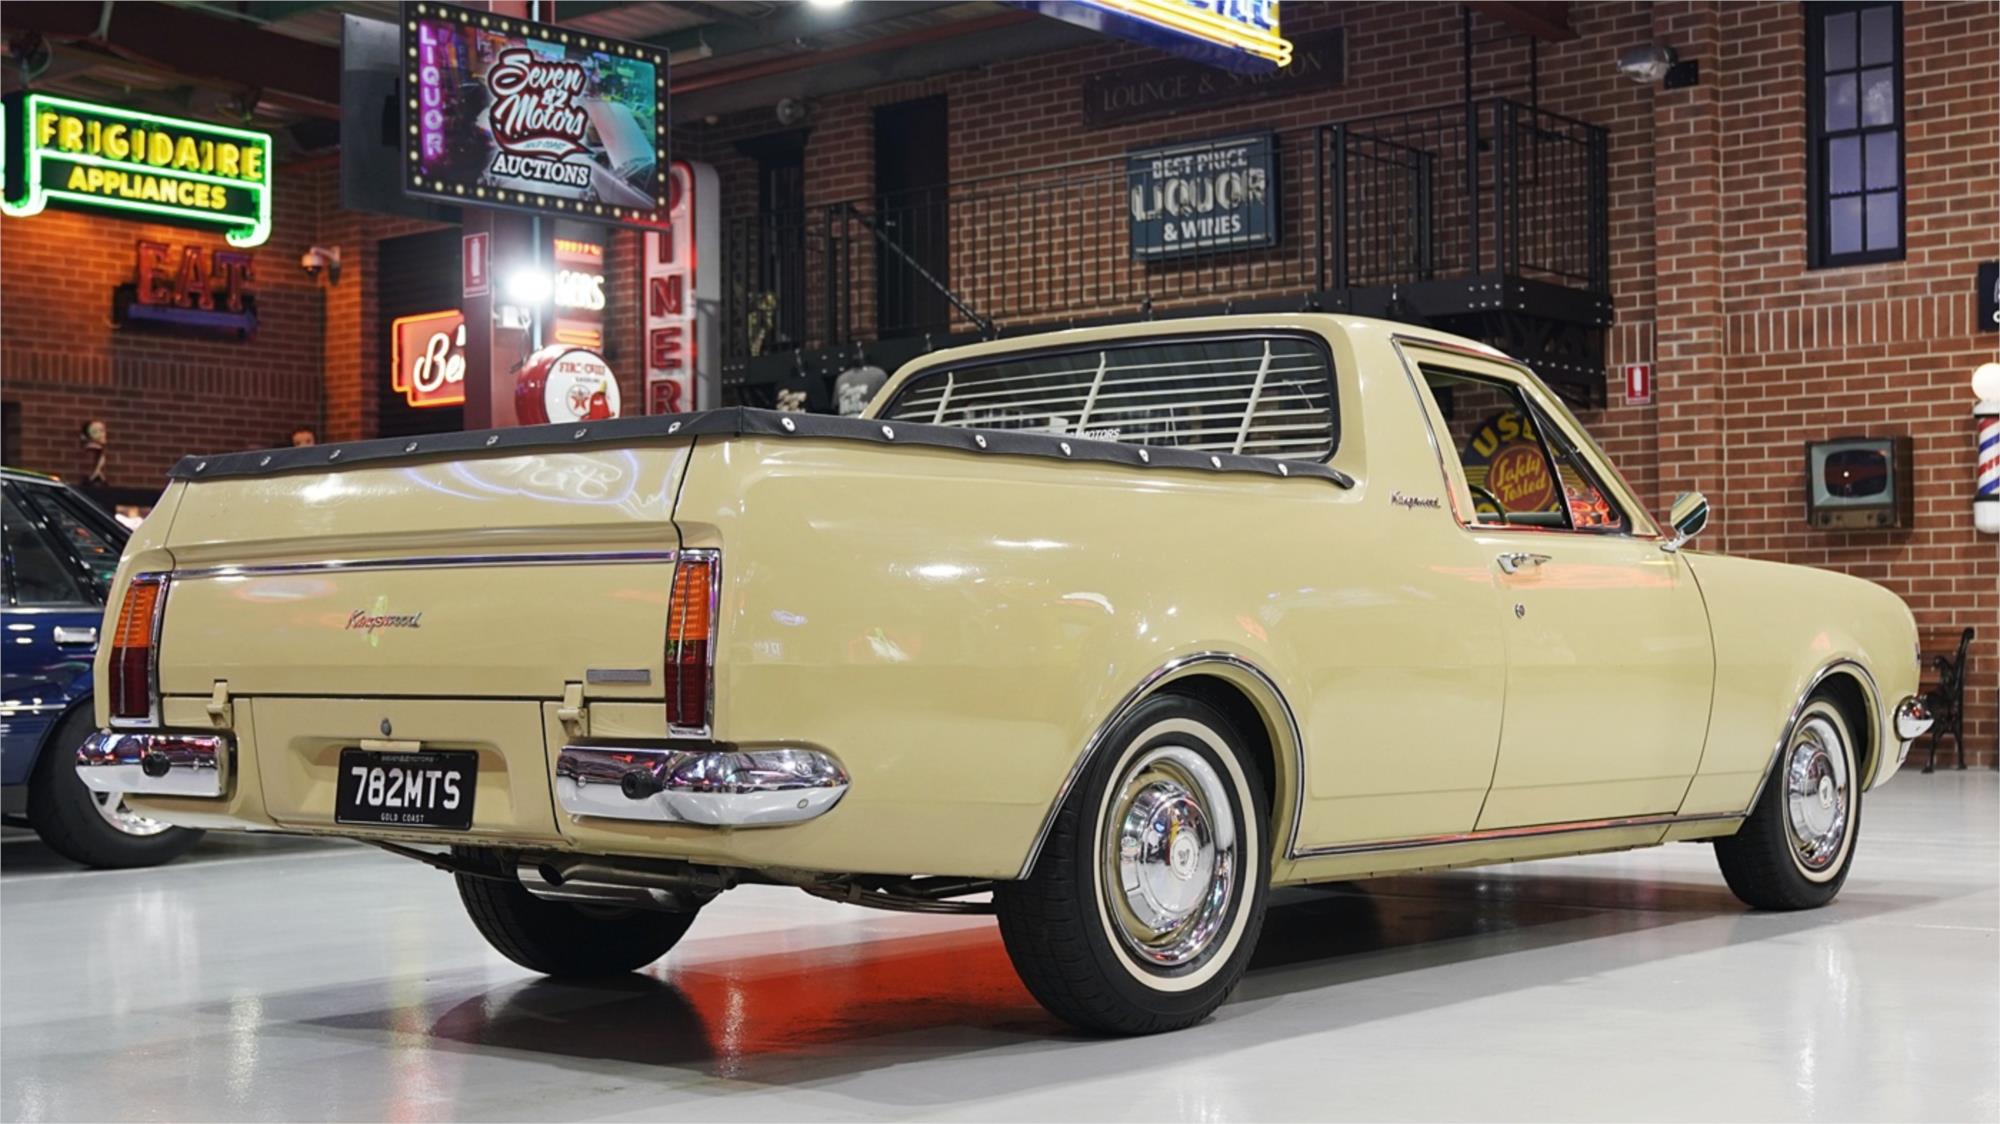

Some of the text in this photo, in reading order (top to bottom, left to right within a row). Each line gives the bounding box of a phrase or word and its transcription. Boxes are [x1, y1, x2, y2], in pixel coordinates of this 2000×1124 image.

[420, 24, 443, 156] LIQUOR
[491, 53, 583, 95] Seven
[1103, 74, 1188, 111] LOUNGE
[1199, 71, 1214, 94] &
[494, 95, 584, 137] Motors
[541, 89, 567, 108] 82
[37, 111, 264, 180] FRIGIDAIRE
[1152, 148, 1248, 179] BEST PRICE
[67, 165, 227, 210] APPLIANCES
[492, 154, 589, 186] AUCTIONS
[1131, 167, 1267, 222] LIQUOR
[1164, 214, 1242, 242] & WINES
[138, 239, 253, 310] EAT
[1472, 411, 1560, 458] USE
[1496, 453, 1542, 487] Safety
[1501, 471, 1547, 503] Tested
[351, 766, 461, 809] 782MTS
[380, 812, 425, 823] GOLD COAST
